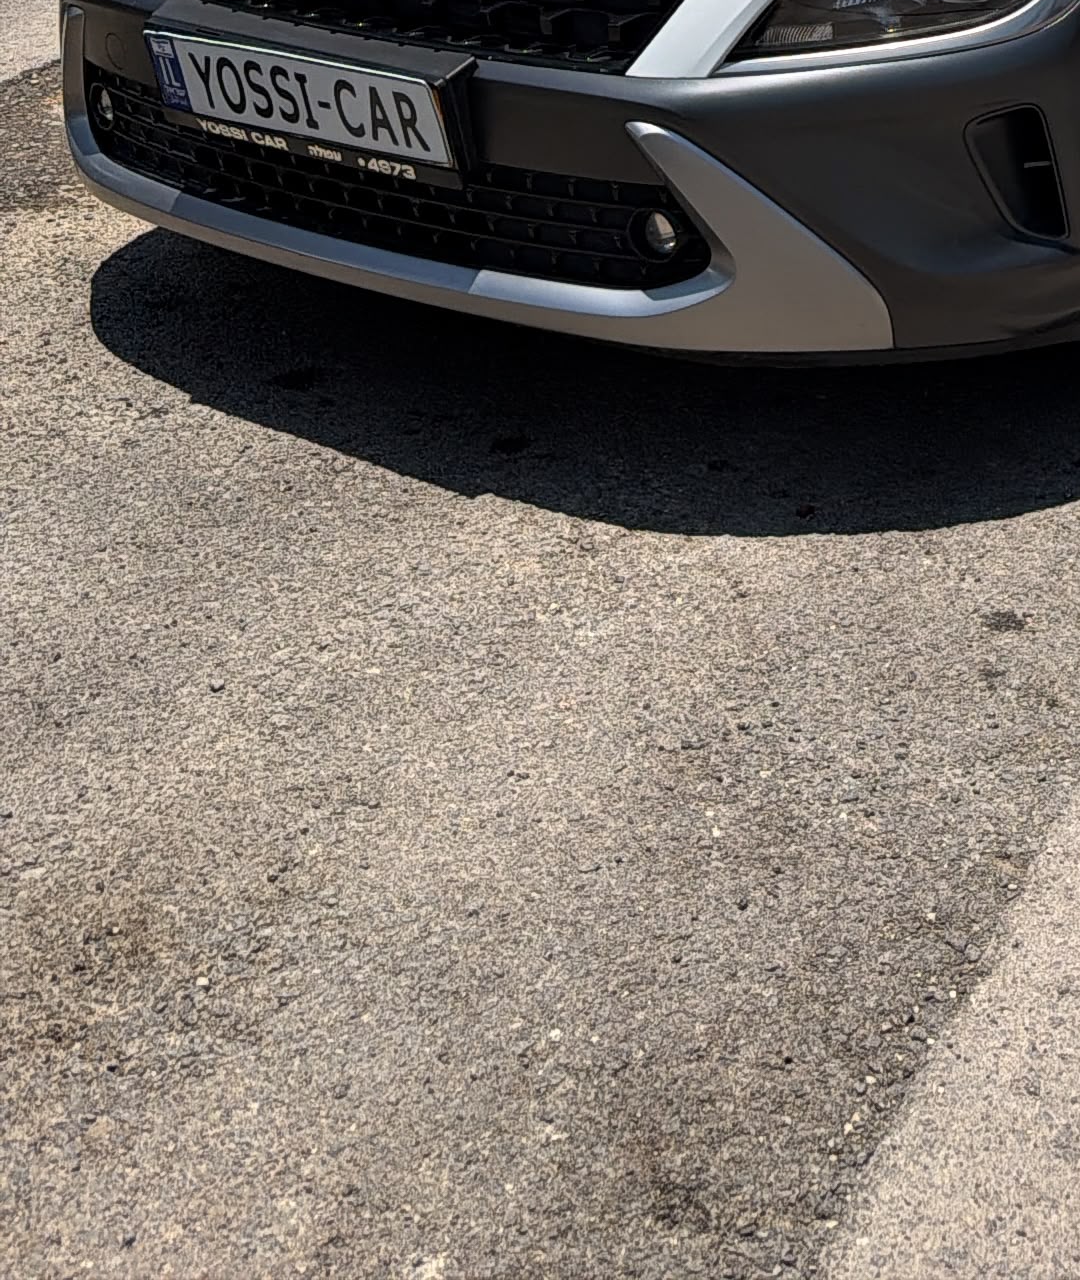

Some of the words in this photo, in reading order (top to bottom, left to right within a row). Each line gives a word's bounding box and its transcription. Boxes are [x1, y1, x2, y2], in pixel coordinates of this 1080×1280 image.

[159, 56, 182, 88] IL
[188, 51, 431, 152] YOSSI-CAR
[197, 118, 249, 141] YOSSI
[250, 131, 290, 152] CAR
